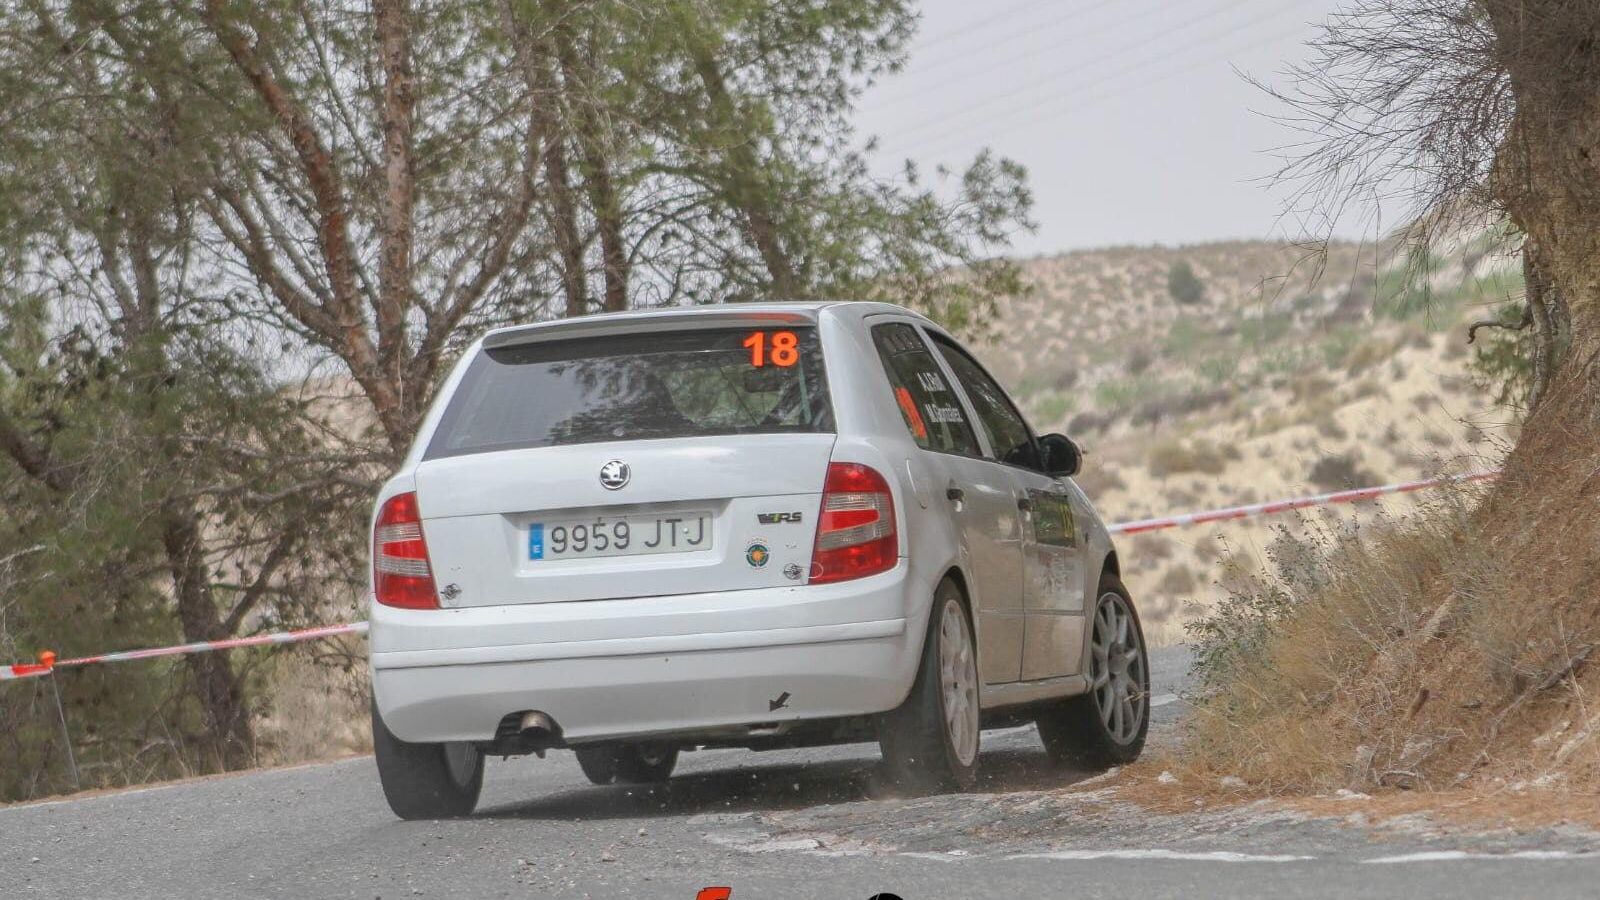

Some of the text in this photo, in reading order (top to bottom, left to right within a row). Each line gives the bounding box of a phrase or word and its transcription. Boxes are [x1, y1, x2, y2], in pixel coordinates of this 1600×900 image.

[743, 331, 799, 367] 18
[532, 544, 542, 554] E
[551, 516, 705, 554] 9959 JTJ
